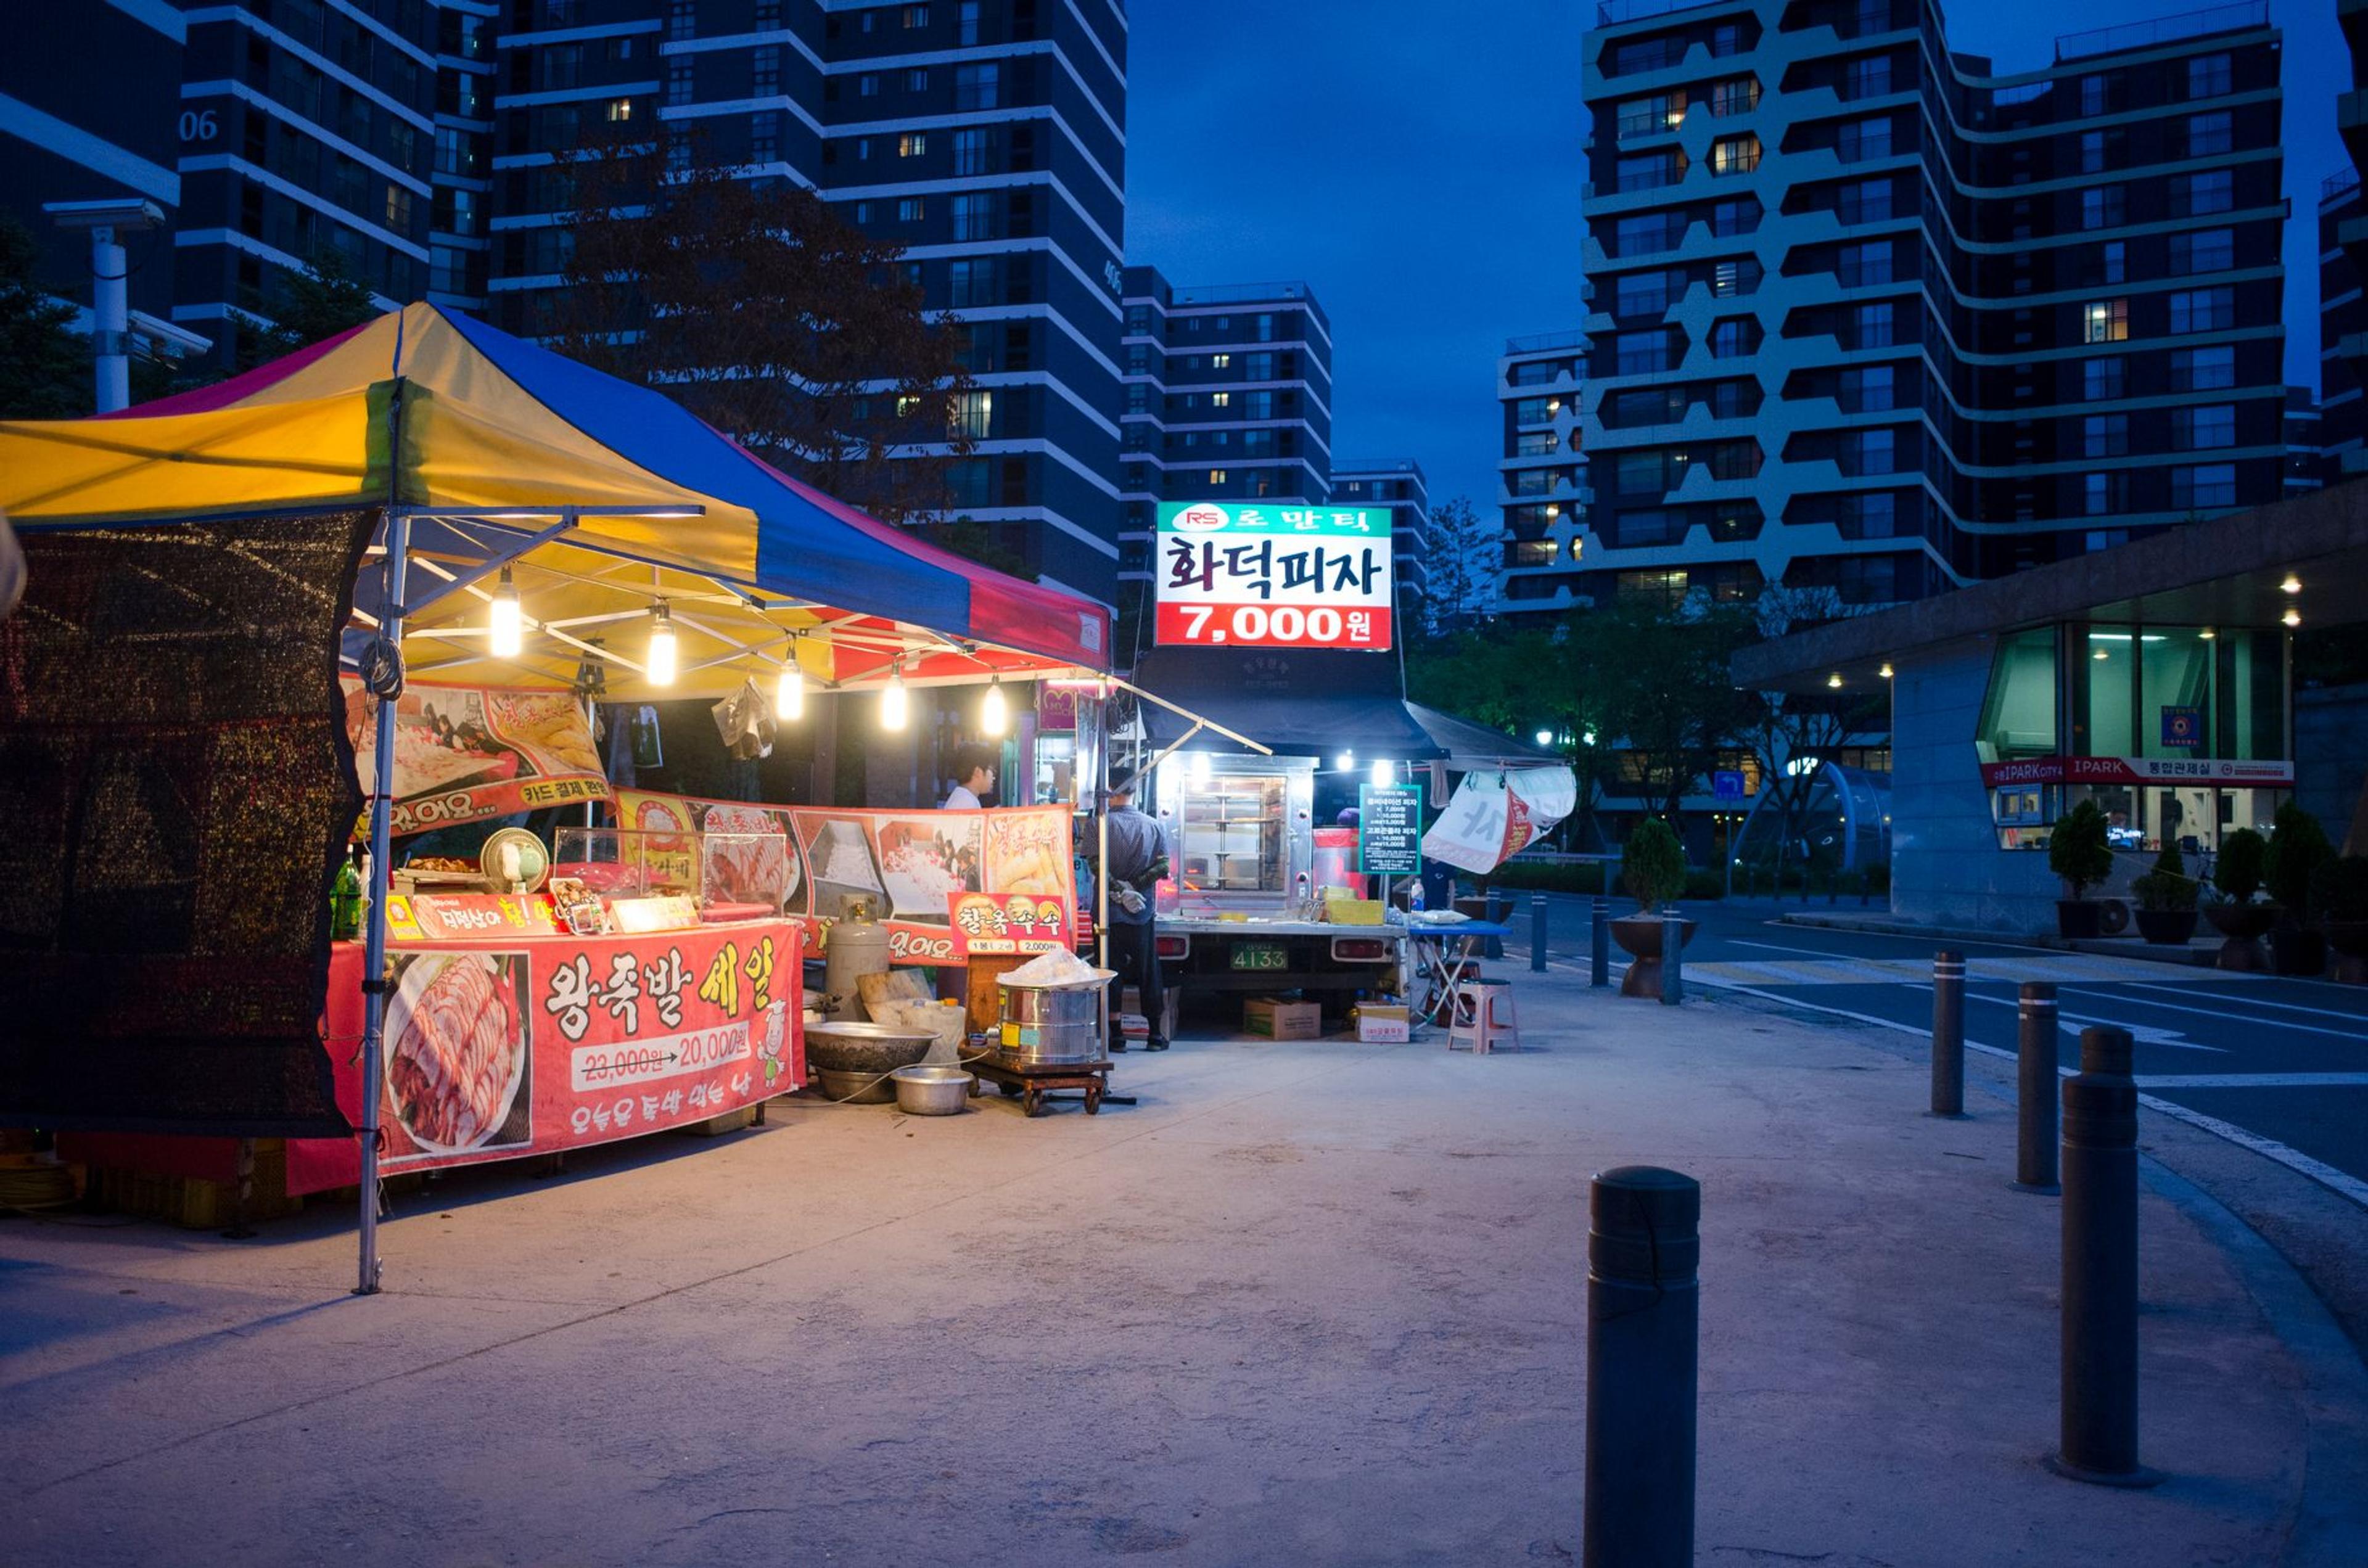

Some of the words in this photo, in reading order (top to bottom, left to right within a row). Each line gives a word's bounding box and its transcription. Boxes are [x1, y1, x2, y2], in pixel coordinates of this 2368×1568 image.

[179, 110, 218, 142] 06
[1186, 512, 1219, 524] RS
[1167, 536, 1383, 599] 화덕피자
[1178, 605, 1371, 643] 7,000원
[2074, 760, 2123, 773] IPARK
[2149, 762, 2210, 775] 통합관제실
[524, 786, 554, 802] 카드
[556, 781, 585, 800] 결제
[958, 907, 1060, 936] 찰옥수수
[1235, 951, 1283, 967] 4133
[545, 946, 693, 1042] 왕족발
[698, 935, 773, 1018] 세일
[680, 1028, 747, 1067] 20,000원
[571, 1098, 634, 1135] 오늘은
